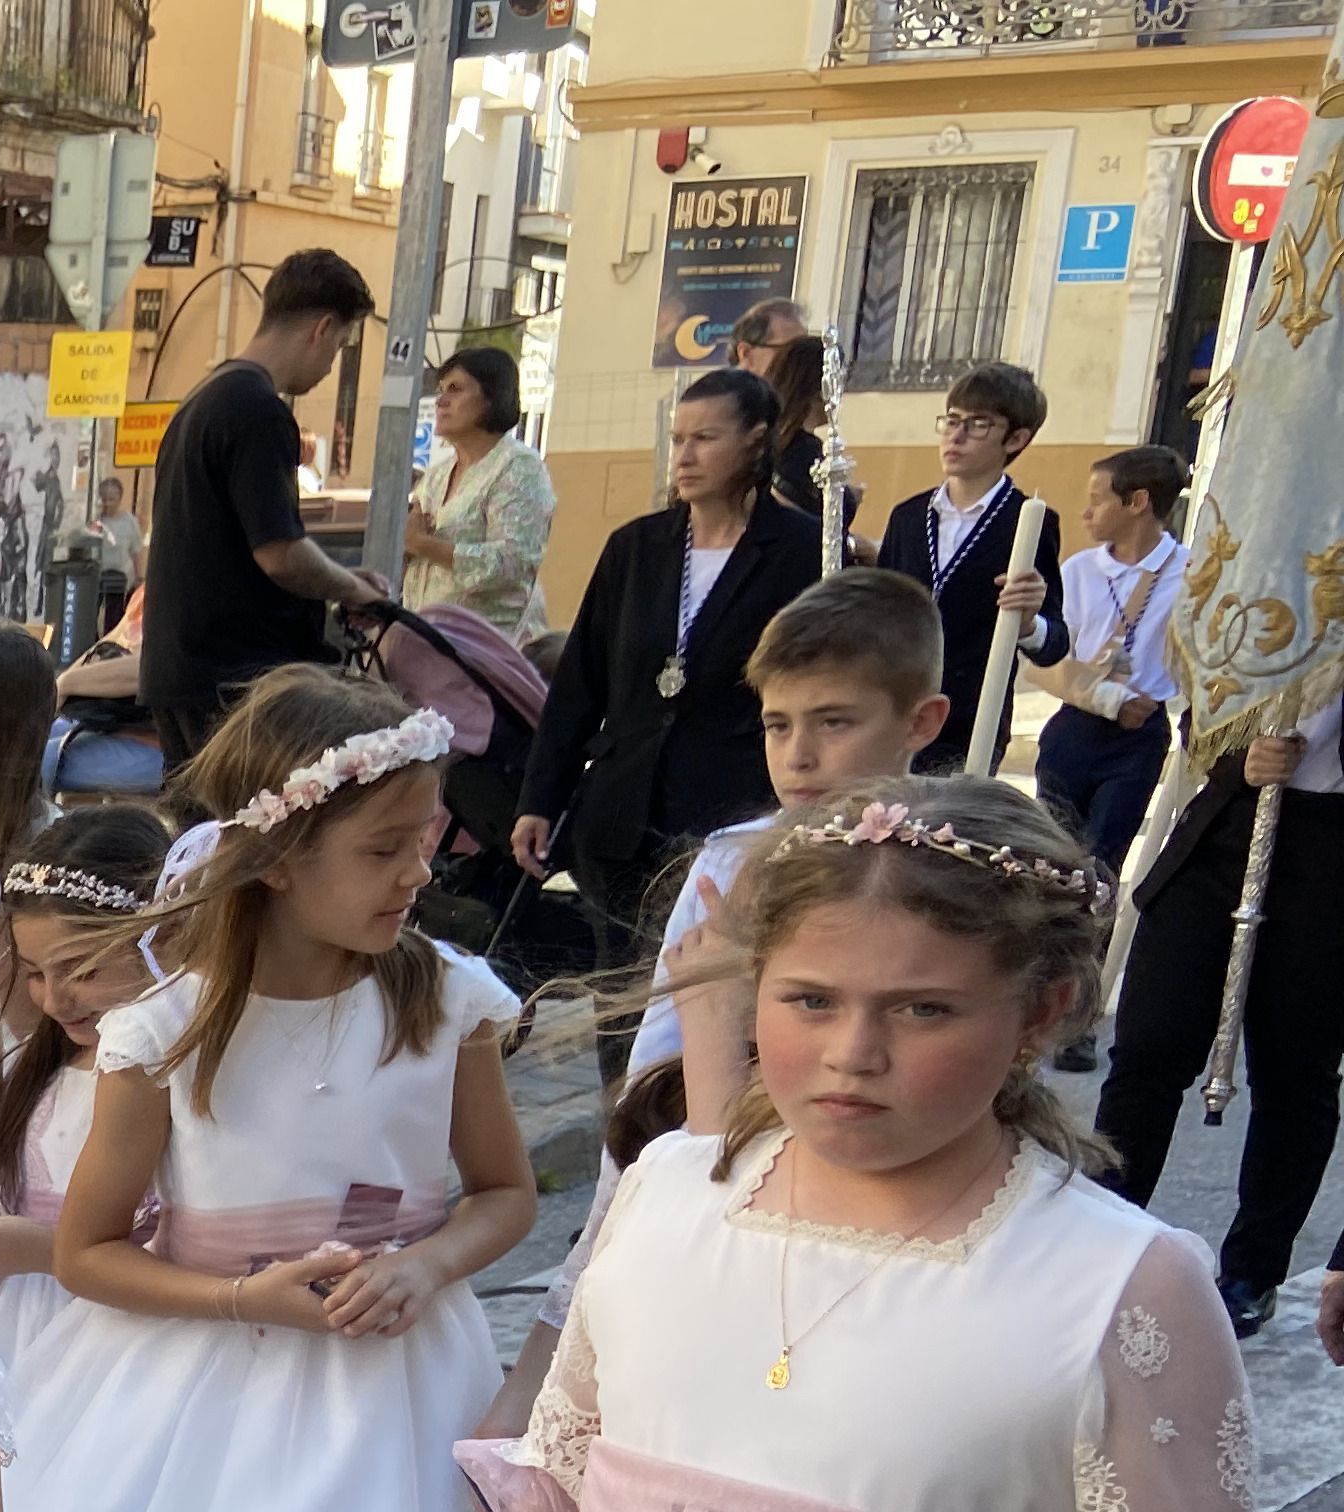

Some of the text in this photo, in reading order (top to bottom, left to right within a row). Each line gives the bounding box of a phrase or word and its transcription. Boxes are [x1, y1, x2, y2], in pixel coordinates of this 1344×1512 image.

[1098, 155, 1120, 173] 34
[673, 186, 798, 230] HOSTAL
[1079, 209, 1120, 251] P
[68, 344, 115, 358] SALIDA
[391, 341, 411, 361] 44
[80, 367, 99, 381] DE
[53, 393, 120, 407] CAMIONES
